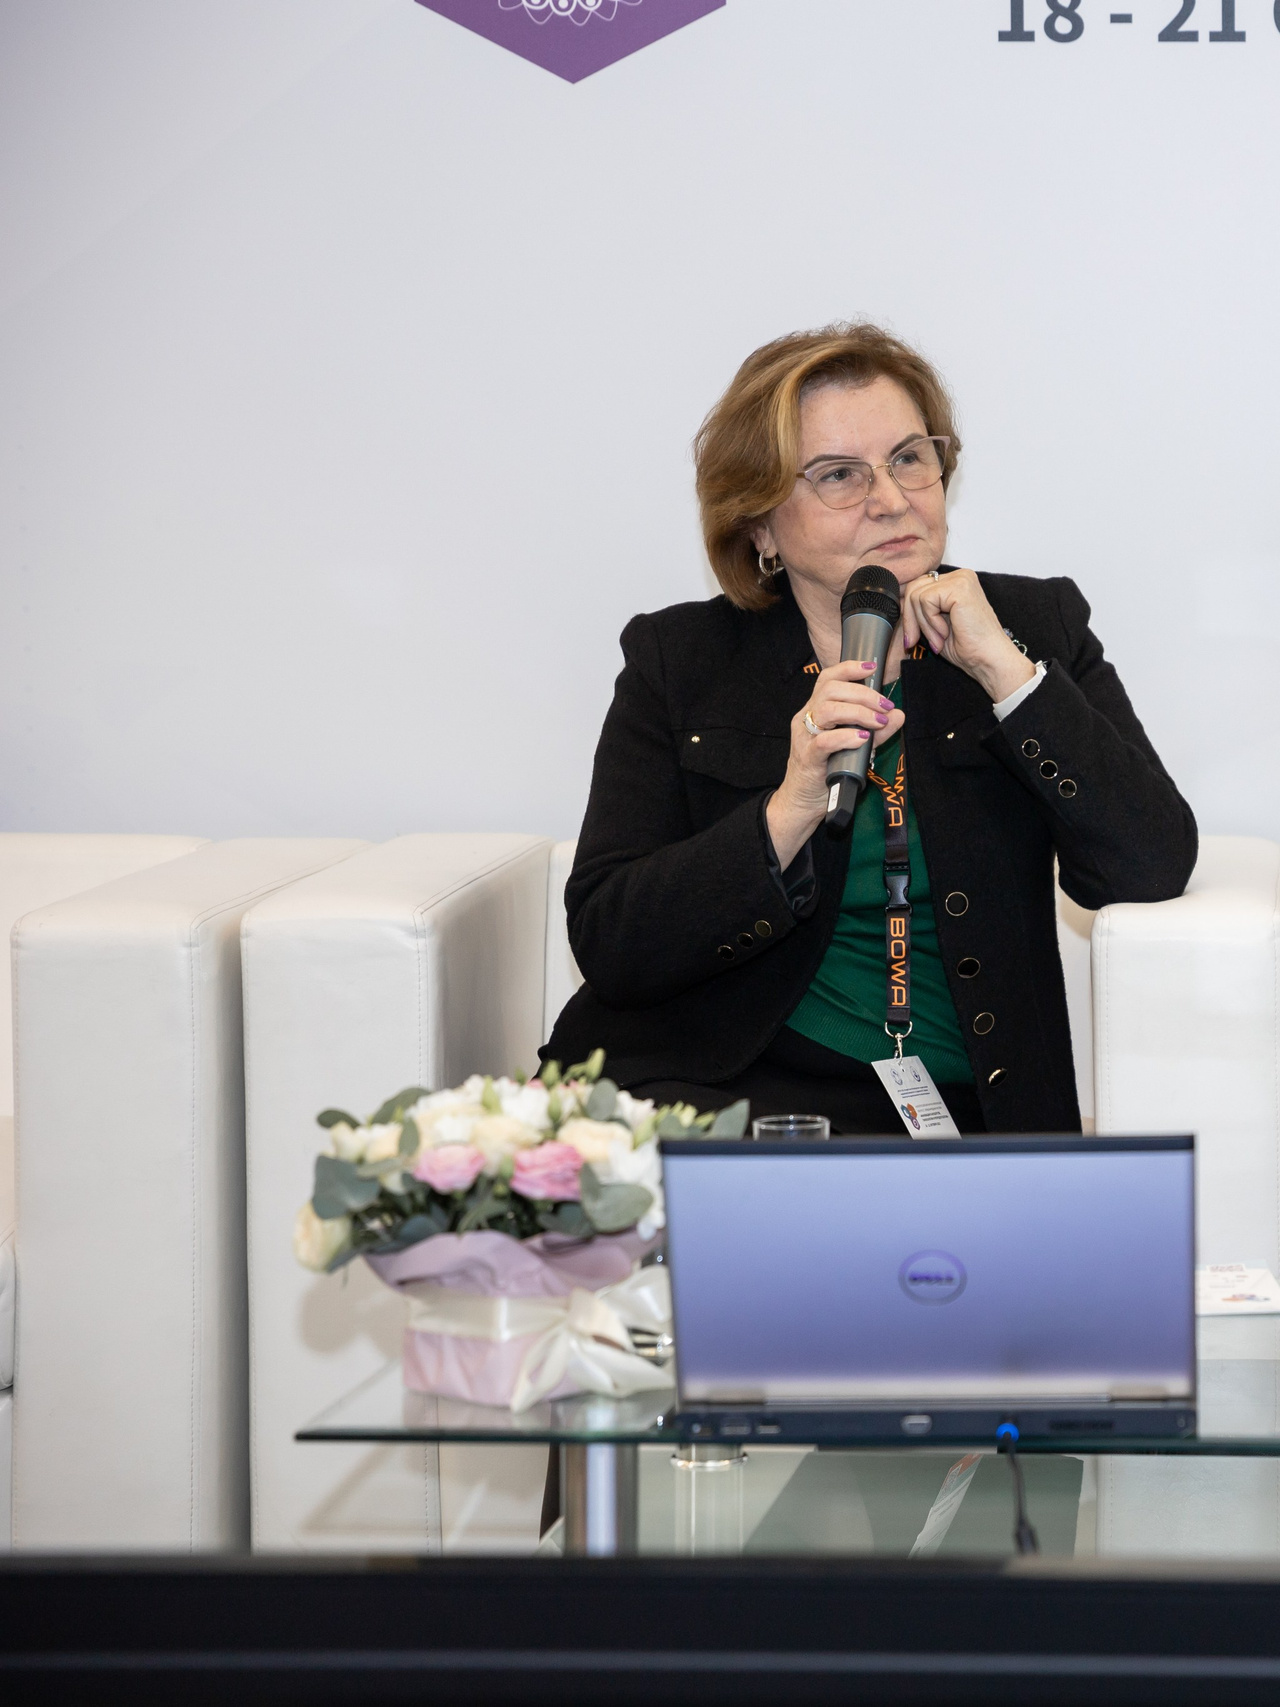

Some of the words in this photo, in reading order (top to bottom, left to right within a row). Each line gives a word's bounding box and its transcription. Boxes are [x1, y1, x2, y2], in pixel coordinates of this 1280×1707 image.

[997, 0, 1085, 43] 18
[1158, 0, 1247, 42] 21
[889, 917, 908, 1006] BOWA
